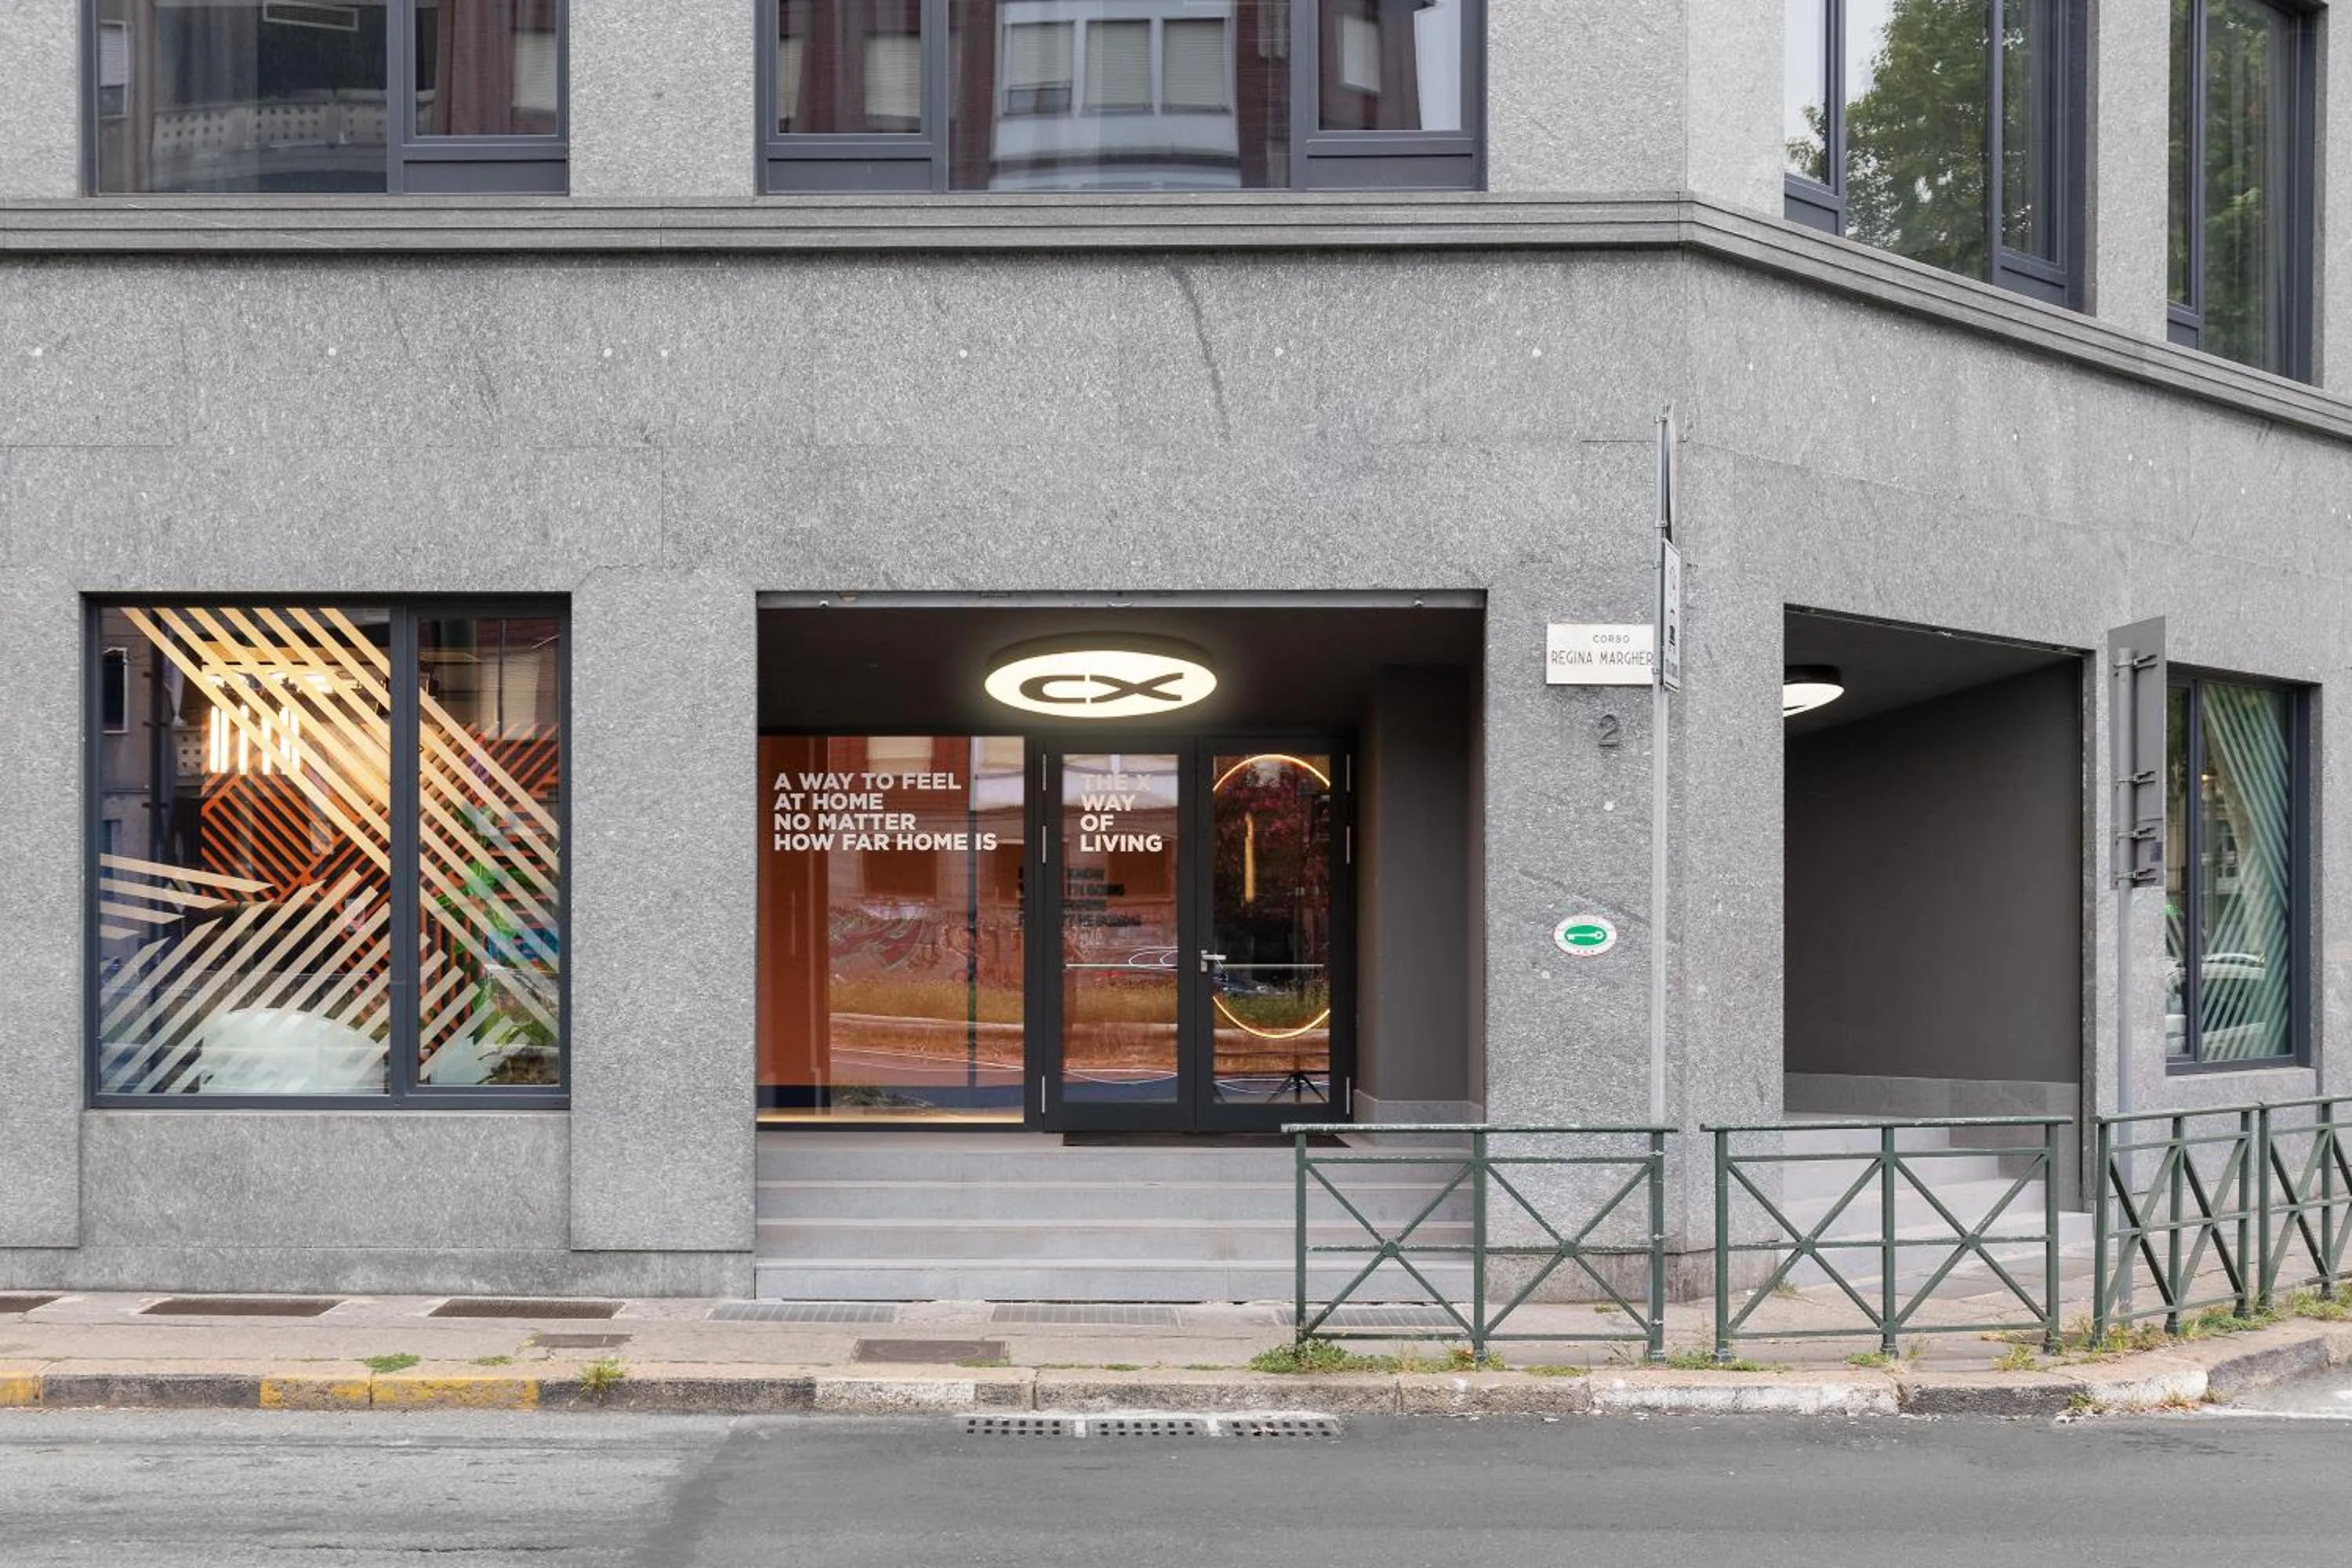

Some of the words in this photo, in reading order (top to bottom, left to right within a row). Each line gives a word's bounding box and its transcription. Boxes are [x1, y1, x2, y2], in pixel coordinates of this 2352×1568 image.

[1592, 634, 1630, 644] CORSO
[1552, 650, 1592, 665] REGINA
[1599, 652, 1653, 665] MARGHER
[1598, 714, 1620, 746] 2
[774, 772, 791, 791] A
[797, 772, 855, 791] WAY
[862, 772, 895, 791] TO
[902, 772, 961, 790] FEEL
[1081, 774, 1129, 791] THE
[1134, 774, 1152, 791] X
[774, 793, 805, 811] AT
[812, 793, 884, 811] HOME
[1081, 794, 1135, 811] WAY
[774, 813, 810, 831] NO
[818, 813, 916, 831] MATTER
[1080, 814, 1114, 832] OF
[774, 833, 834, 851] HOW
[842, 833, 890, 851] FAR
[896, 833, 968, 851] HOME
[975, 833, 998, 851] IS
[1080, 833, 1163, 852] LIVING
